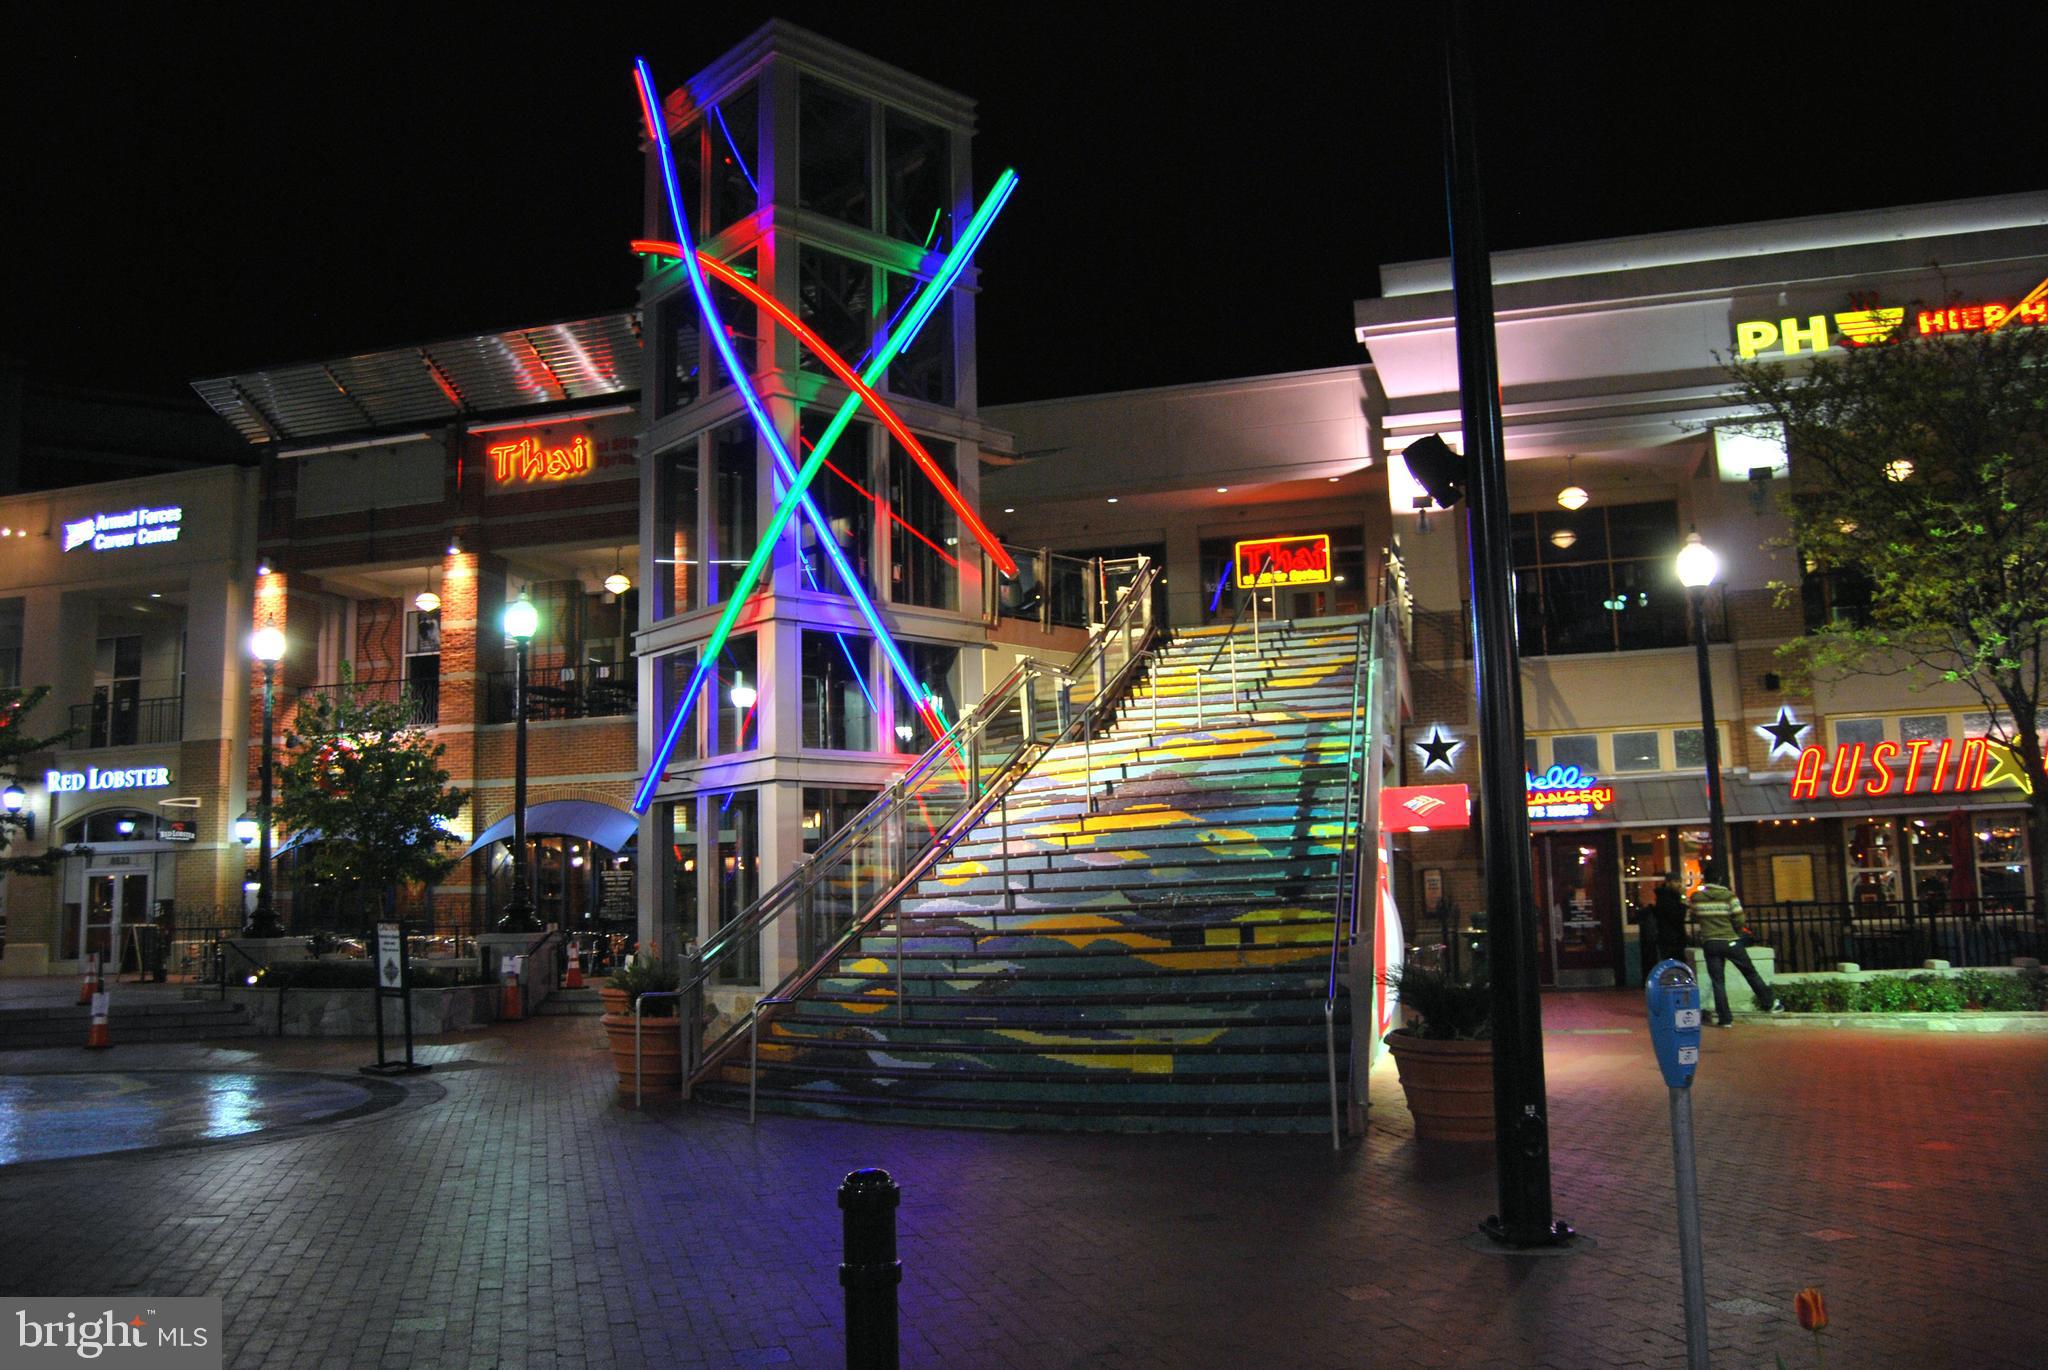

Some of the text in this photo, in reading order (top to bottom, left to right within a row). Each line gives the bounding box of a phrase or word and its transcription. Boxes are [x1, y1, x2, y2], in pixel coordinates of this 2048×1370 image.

[490, 436, 591, 482] Thai
[96, 507, 182, 532] Armed Forces
[95, 526, 181, 550] Career Center
[1241, 541, 1327, 573] Thai
[47, 768, 170, 792] RED LOBSTER
[1790, 738, 1989, 799] AUSTIN
